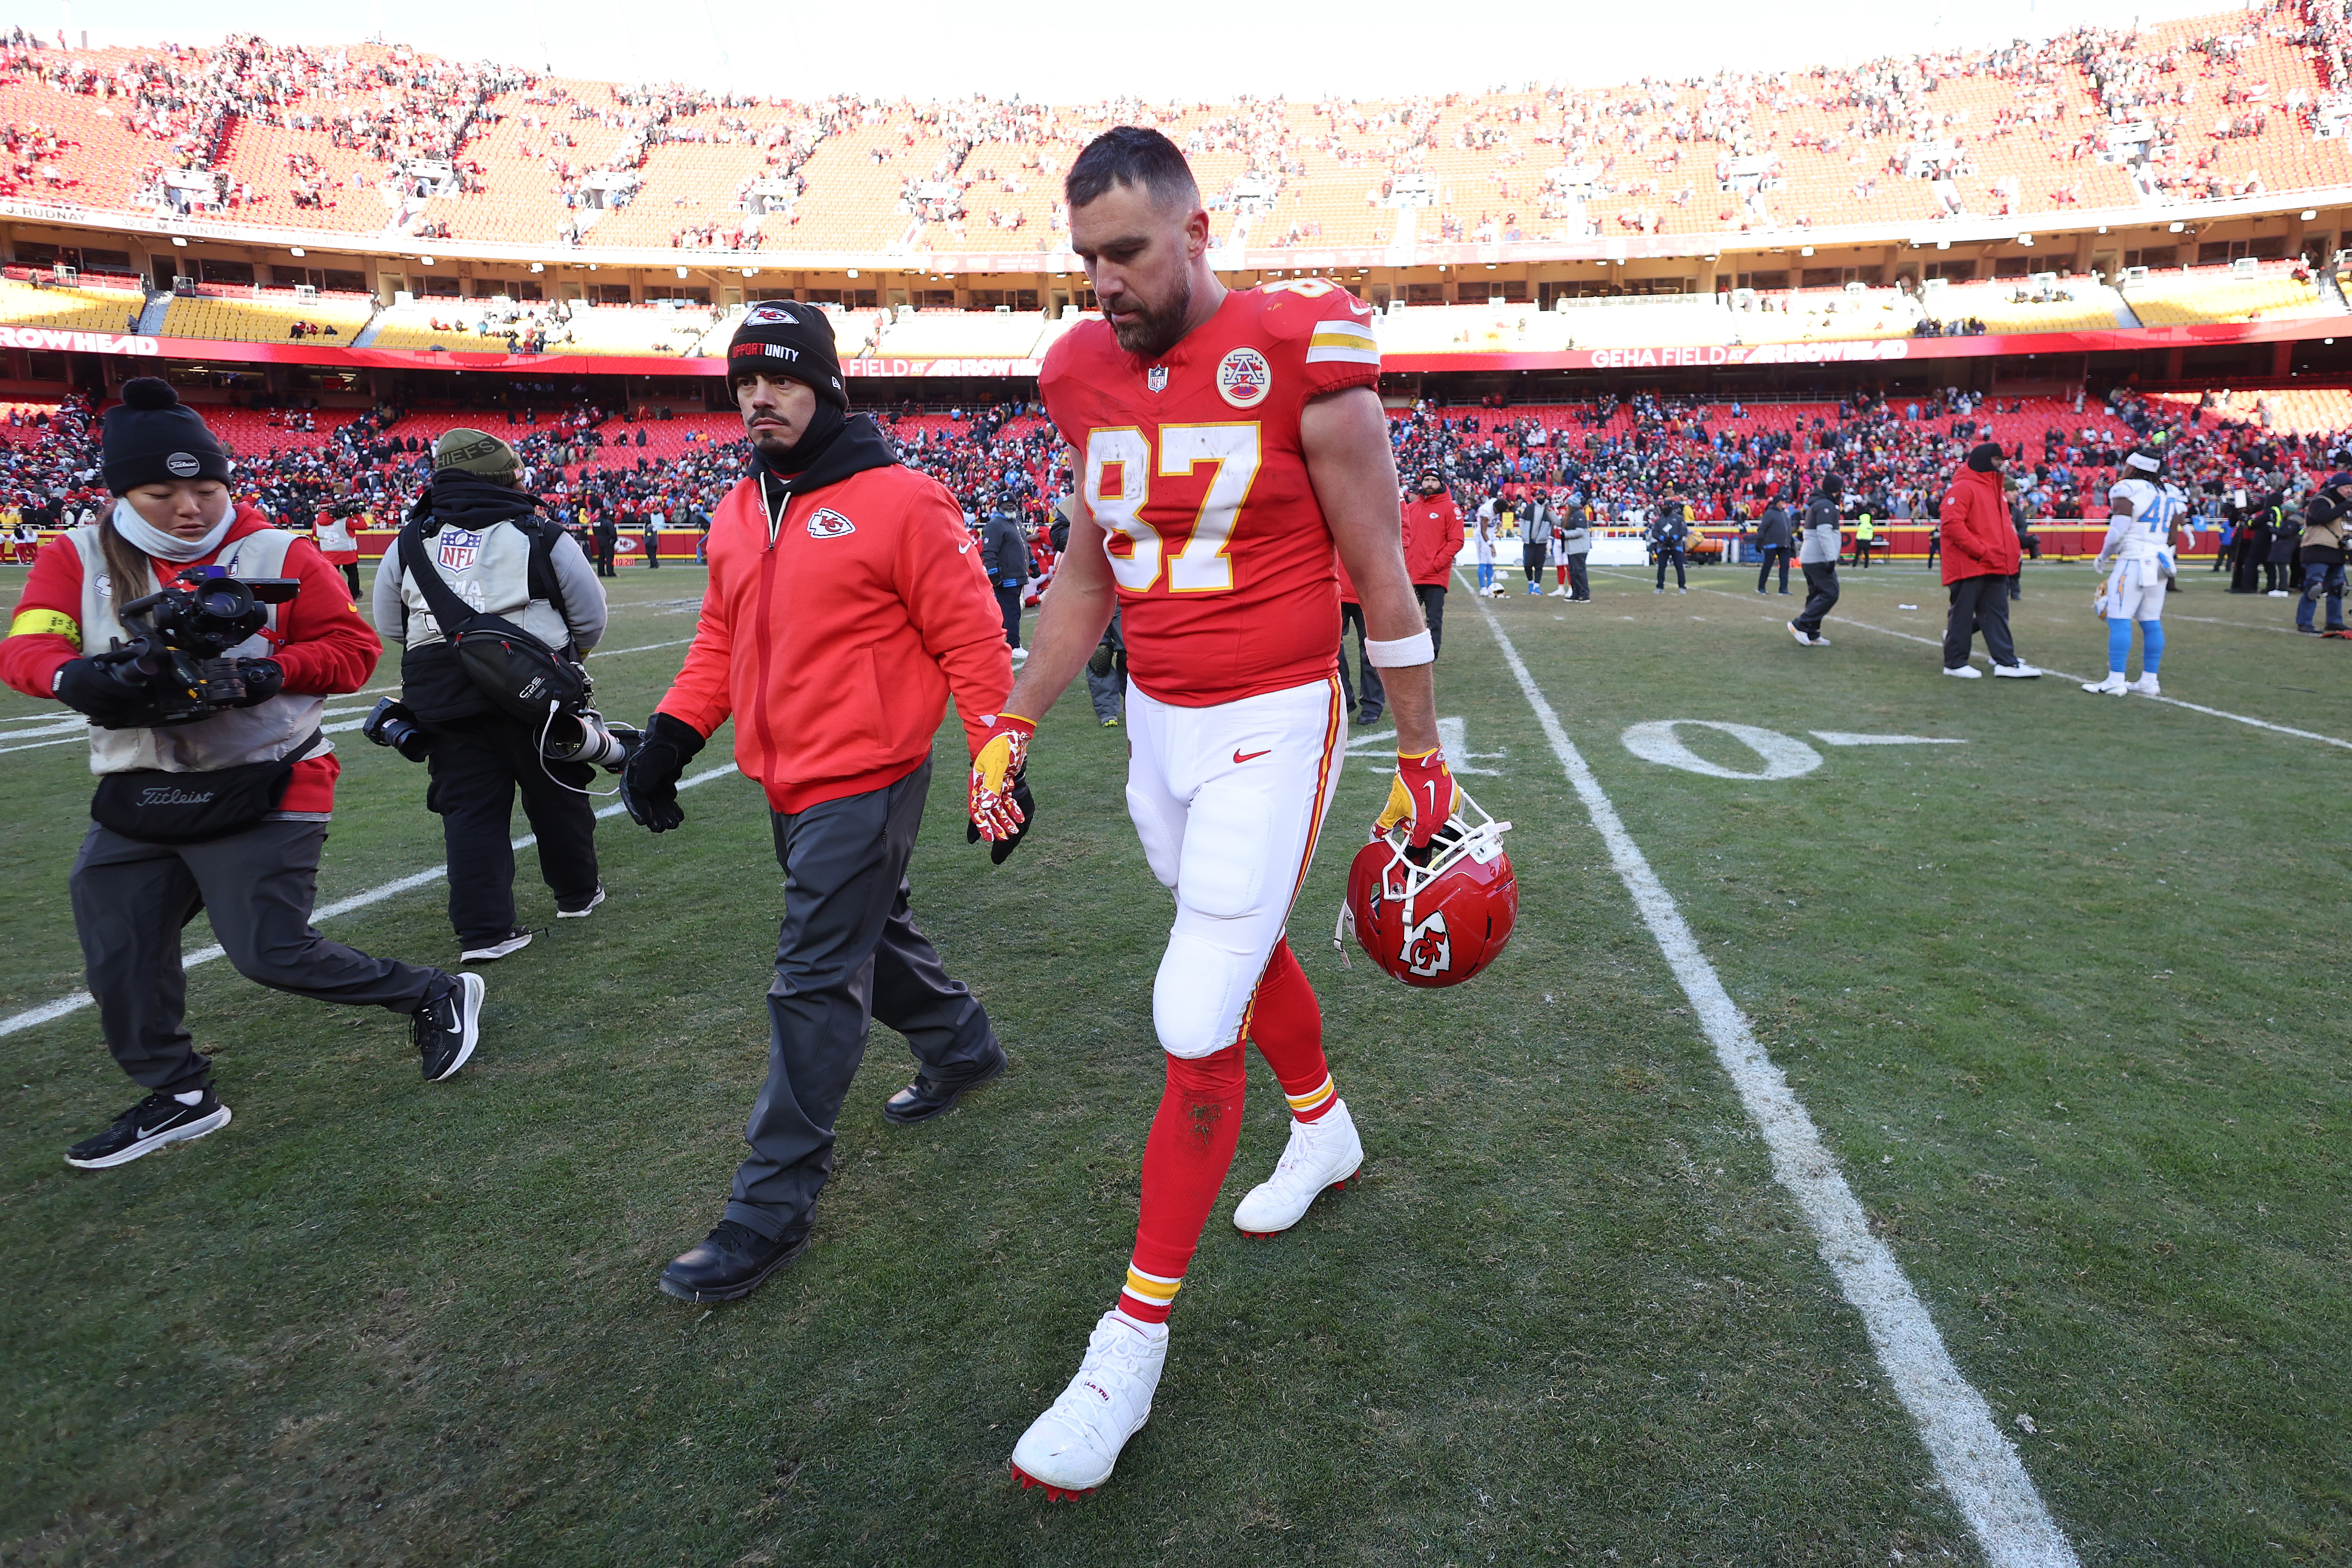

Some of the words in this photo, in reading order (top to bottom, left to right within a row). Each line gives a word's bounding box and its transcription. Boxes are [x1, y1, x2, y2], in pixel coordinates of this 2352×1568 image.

[6, 206, 18, 214] J.
[22, 207, 86, 221] RUDNAY
[1591, 348, 1658, 368] GEHA
[1662, 346, 1727, 367] FIELD
[1728, 348, 1747, 361] AT
[1744, 339, 1908, 364] ARROWHEAD
[849, 359, 908, 376] FIELD
[910, 362, 928, 374] AT
[1150, 377, 1163, 388] NFL
[1084, 420, 1262, 593] 87
[2138, 496, 2176, 533] 40
[820, 516, 843, 532] KC
[442, 547, 474, 568] NFL
[136, 787, 214, 806] Titleist
[1410, 926, 1446, 970] KC
